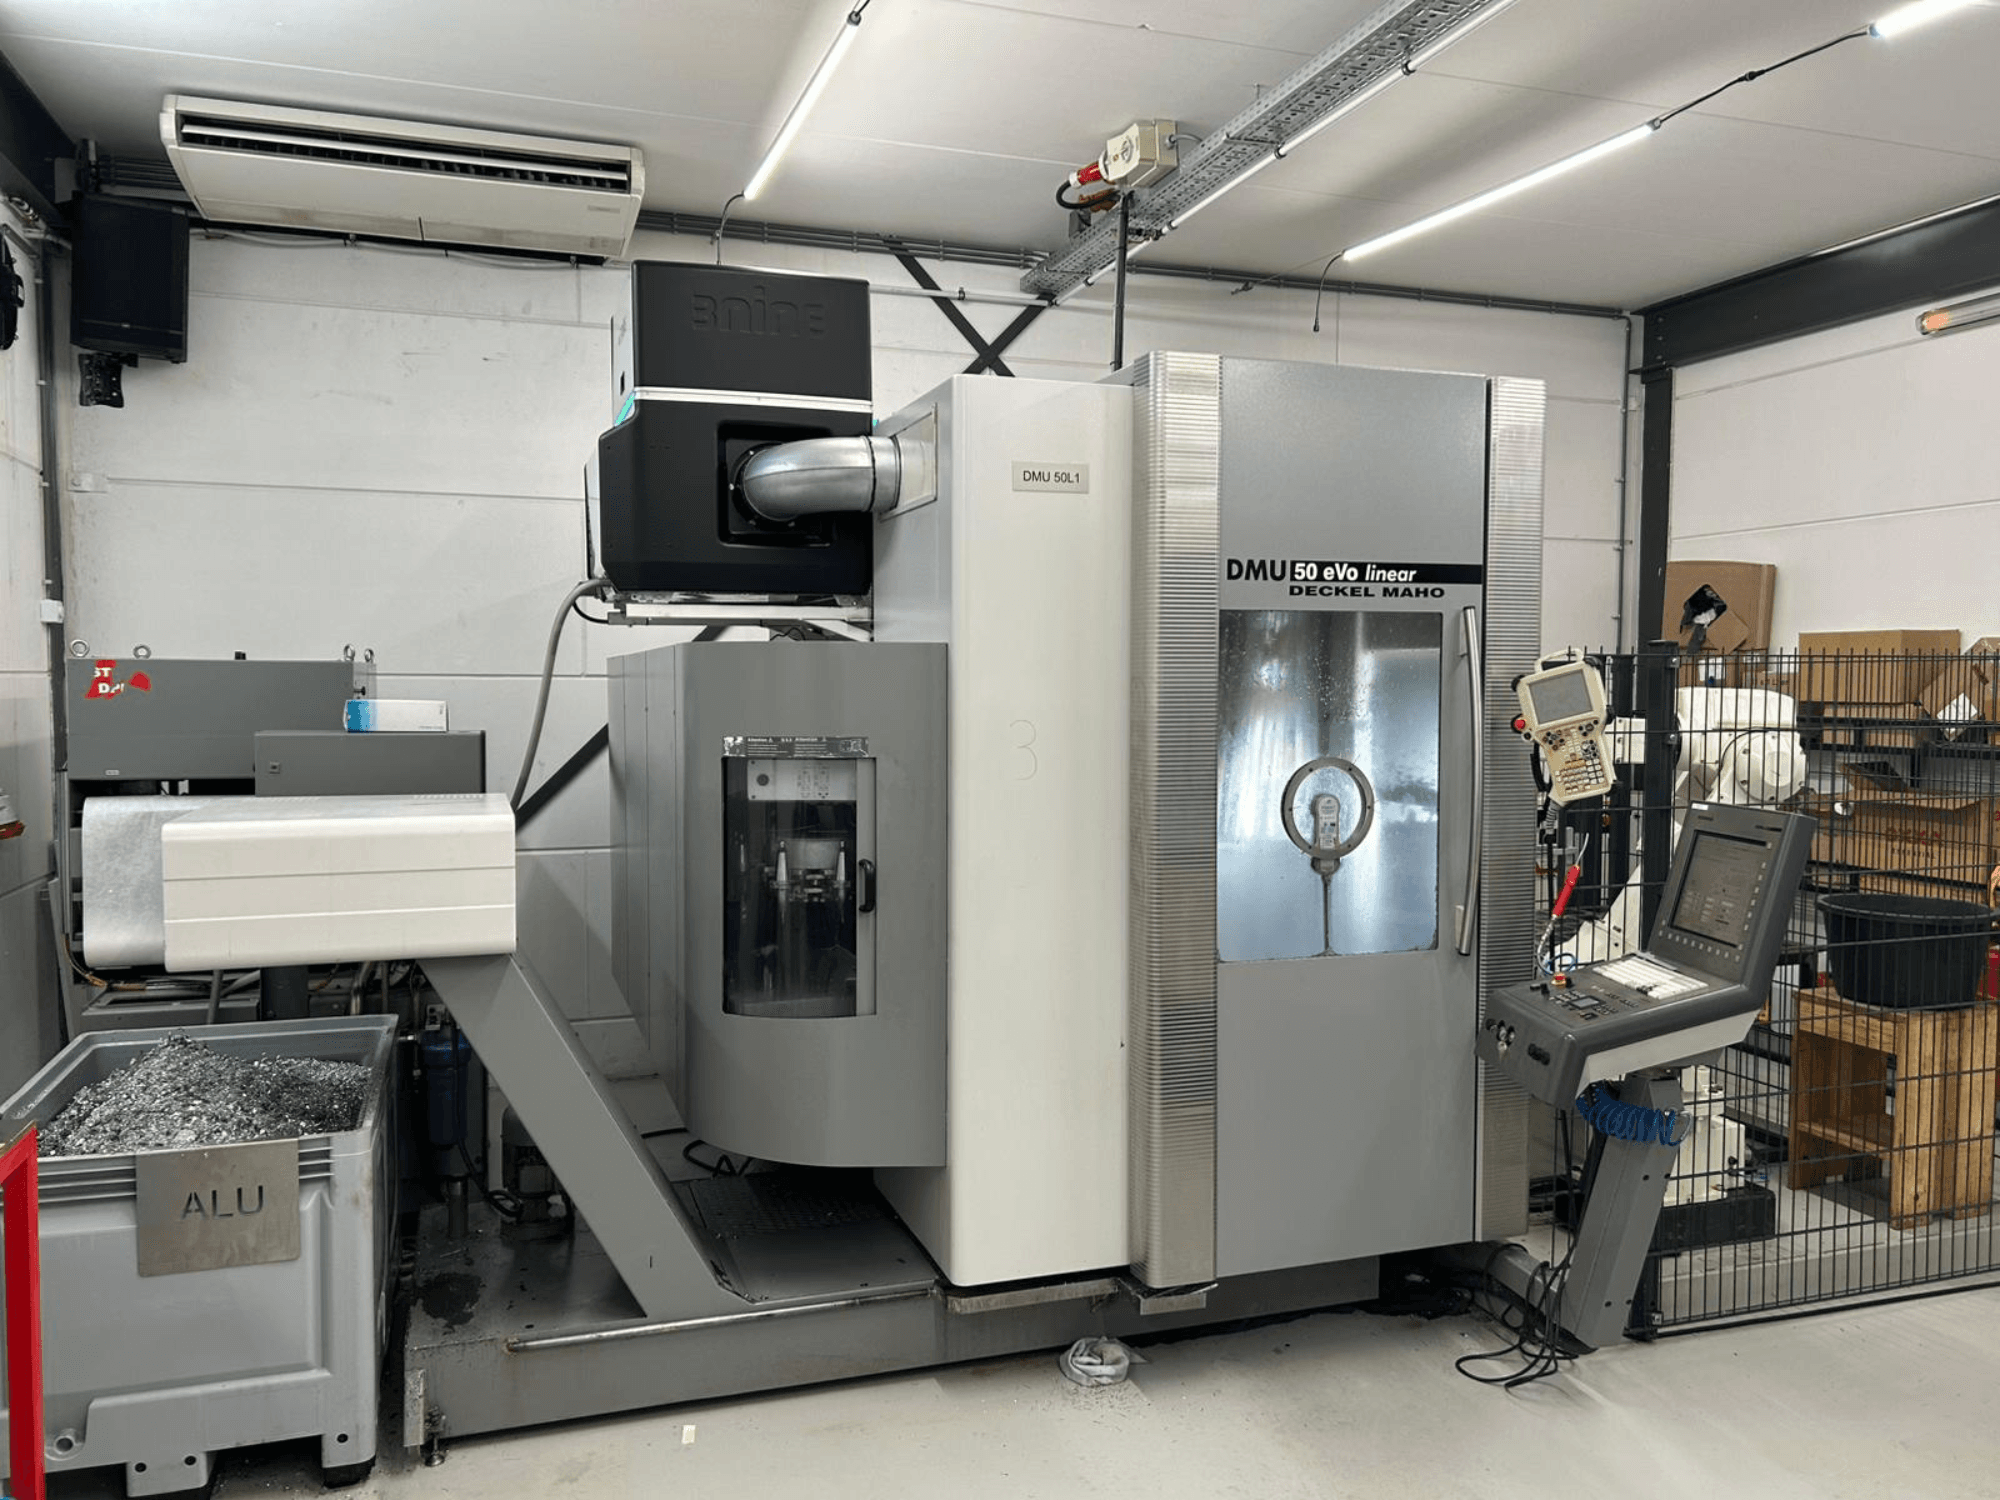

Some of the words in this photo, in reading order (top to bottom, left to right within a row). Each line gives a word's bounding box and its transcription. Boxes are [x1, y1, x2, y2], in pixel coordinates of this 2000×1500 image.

[1023, 470, 1050, 482] DMU
[1054, 471, 1080, 483] 50L1
[1227, 558, 1286, 581] DMU
[1294, 562, 1318, 581] 50
[1323, 563, 1359, 581] eVo
[1365, 563, 1417, 582] linear
[1289, 585, 1375, 597] DECKEL
[1382, 586, 1445, 598] MAHO
[1009, 719, 1038, 781] 3
[181, 1185, 264, 1220] ALU
